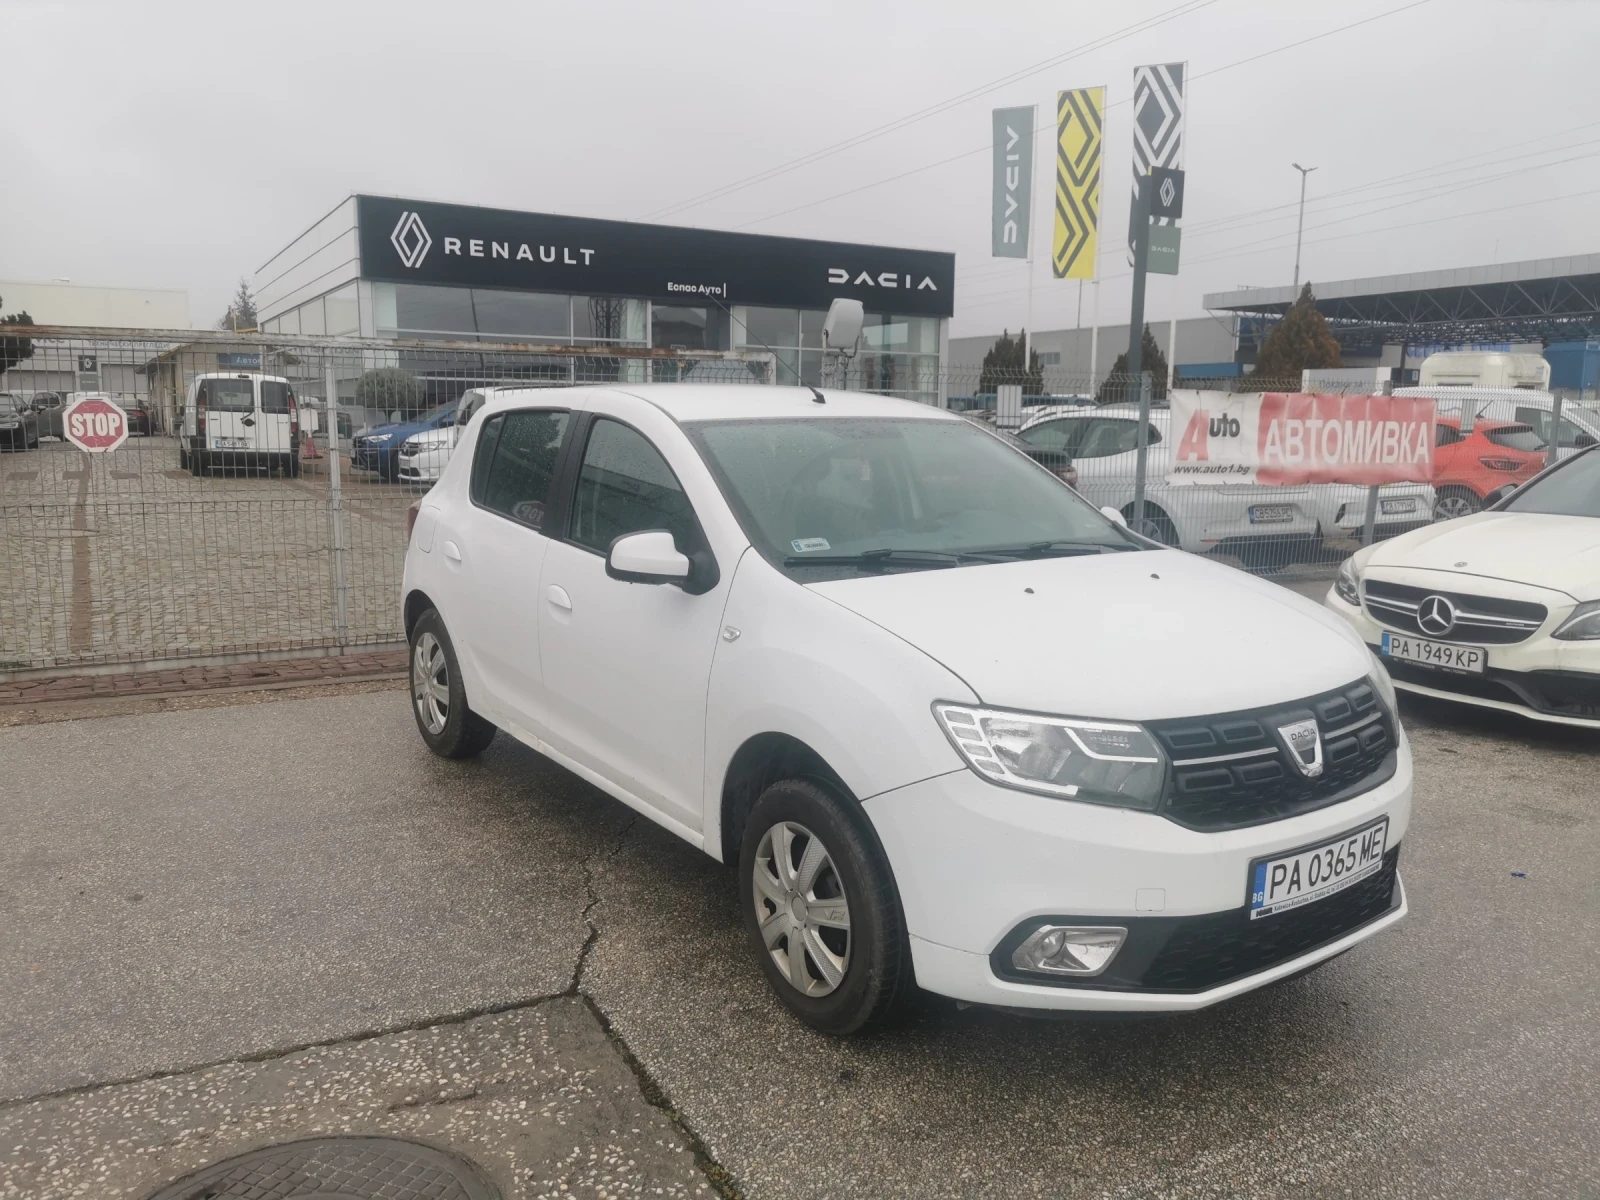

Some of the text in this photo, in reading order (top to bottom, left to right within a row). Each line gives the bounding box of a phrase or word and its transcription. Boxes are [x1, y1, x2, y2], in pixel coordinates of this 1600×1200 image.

[445, 237, 595, 266] RENAULT
[1151, 245, 1176, 254] DACIA
[667, 281, 722, 296] Еспас Ауто
[828, 267, 938, 291] DACIA
[71, 413, 121, 437] STOP
[1176, 408, 1241, 461] Auto
[1263, 418, 1430, 465] АВТОМИВКА
[1174, 464, 1250, 475] www.auto1.bg
[1391, 638, 1410, 656] PA
[1416, 642, 1453, 664] 1949
[1456, 649, 1479, 668] KP
[1290, 728, 1316, 741] DACIA
[1252, 826, 1383, 904] BG PA 0365 ME
